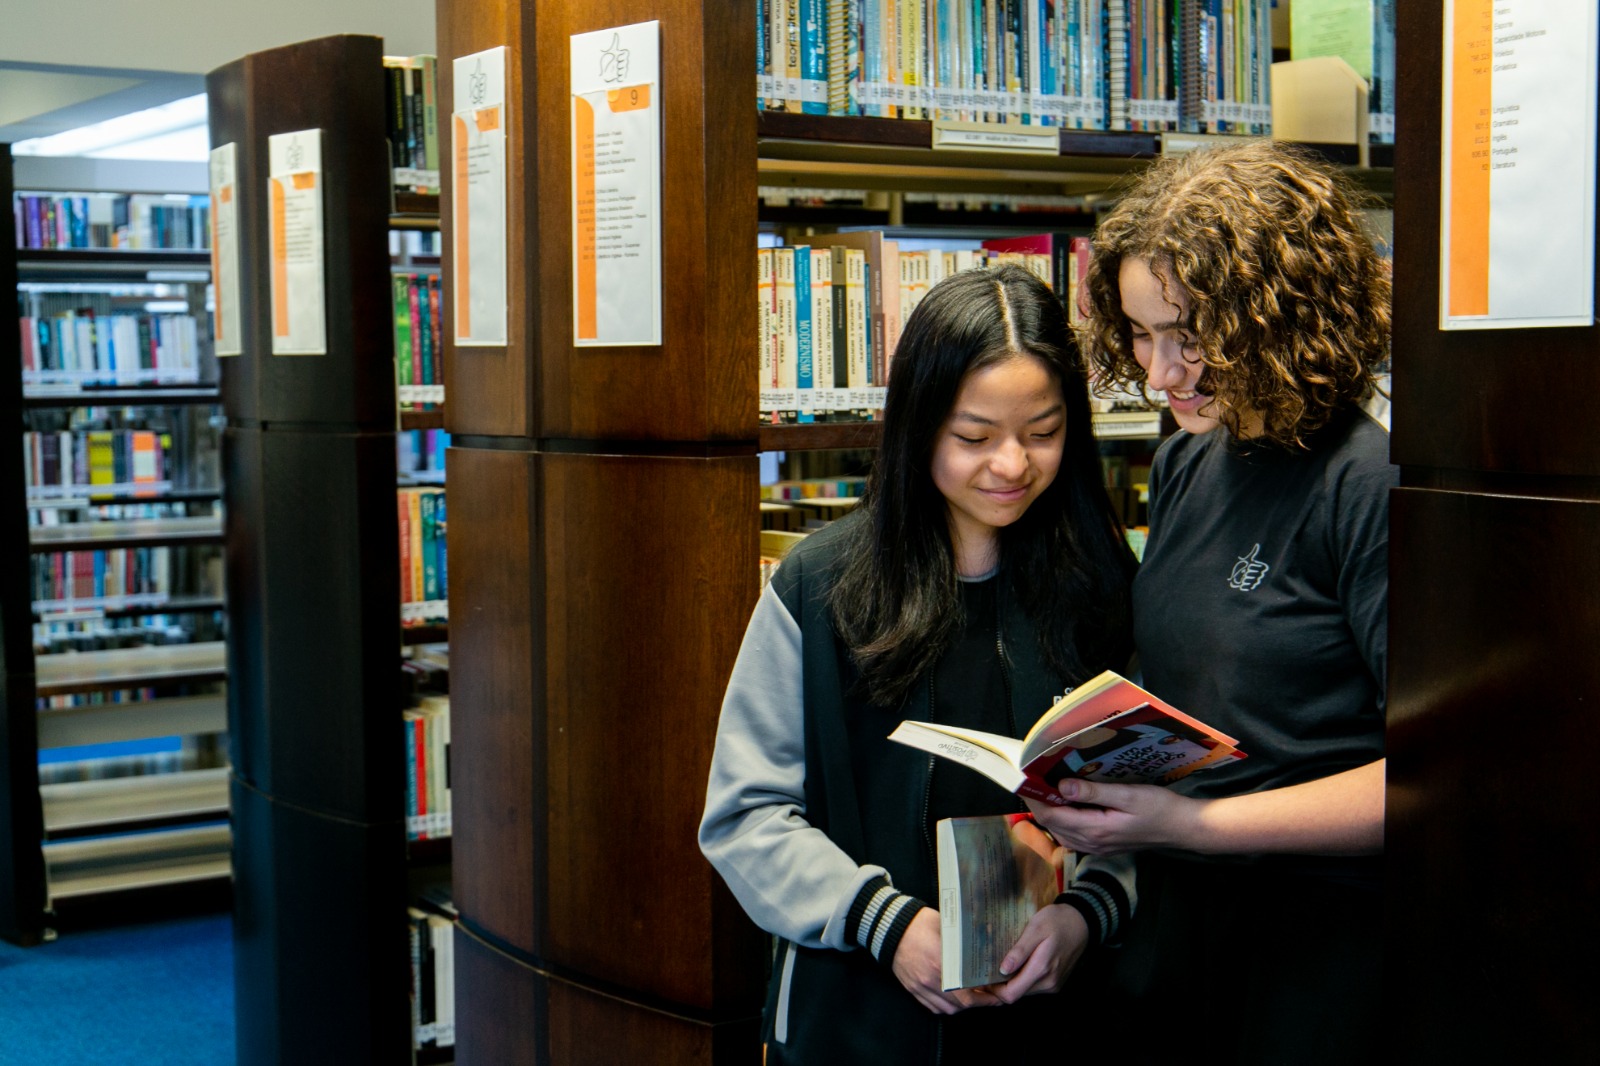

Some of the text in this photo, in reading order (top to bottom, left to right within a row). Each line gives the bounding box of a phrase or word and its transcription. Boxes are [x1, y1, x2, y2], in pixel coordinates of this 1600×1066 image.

[787, 33, 797, 67] teoria
[630, 89, 639, 106] 9
[799, 319, 812, 378] MODERNISMO
